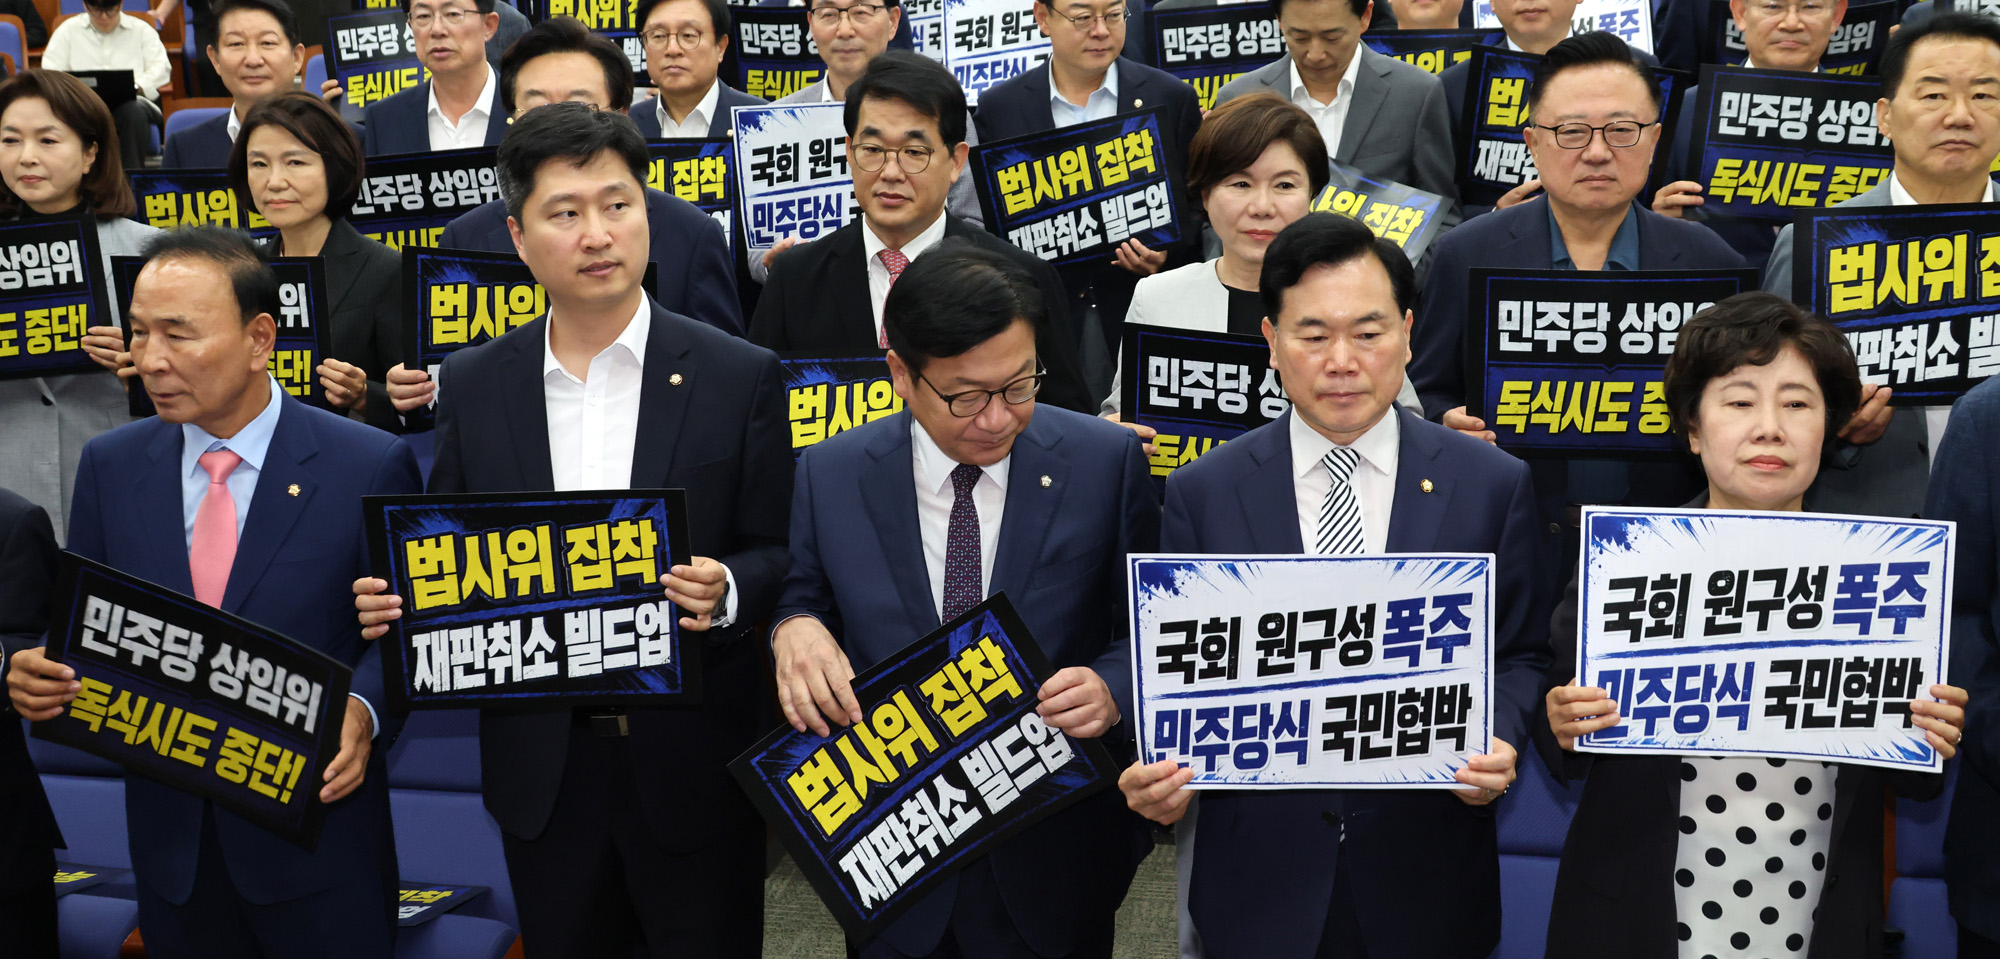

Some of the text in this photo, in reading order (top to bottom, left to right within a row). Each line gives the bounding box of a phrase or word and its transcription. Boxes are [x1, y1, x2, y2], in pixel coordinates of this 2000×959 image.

[337, 24, 399, 60] 민주당
[740, 22, 801, 55] 민주당
[954, 15, 994, 51] 국회
[1001, 9, 1050, 45] 원구
[1163, 19, 1288, 62] 민주당 상임
[1827, 20, 1876, 55] 임위
[1718, 92, 1892, 147] 민주당 상임
[672, 156, 726, 202] 집착
[751, 136, 848, 187] 국회 원구
[997, 128, 1156, 216] 법사위 집착
[1708, 158, 1826, 206] 독식시도
[145, 188, 239, 230] 법사위
[753, 193, 842, 244] 민주당식
[1100, 181, 1172, 244] 빌드업
[1829, 234, 1968, 314] 법사위
[25, 304, 87, 355] 중단!
[430, 283, 546, 345] 법사위
[1498, 301, 1716, 354] 민주당 상임
[1843, 320, 1961, 387] 판취소
[1148, 356, 1252, 415] 민주당
[1496, 381, 1634, 434] 독식시도
[406, 519, 658, 611] 법사위 집착
[1602, 561, 1930, 643] 국회 원구성 폭주
[81, 595, 324, 735] 민주당 상임위
[412, 600, 671, 693] 재판취소 빌드업
[1156, 592, 1474, 685] 국회 원구성 폭주
[1592, 655, 1924, 740] 민주당식 국민협박
[69, 676, 307, 804] 독식시도 중단!
[787, 636, 1023, 836] 법사위 집착
[1154, 683, 1473, 773] 민주당식 국민협박
[838, 711, 1076, 910] 재판취소 빌드업
